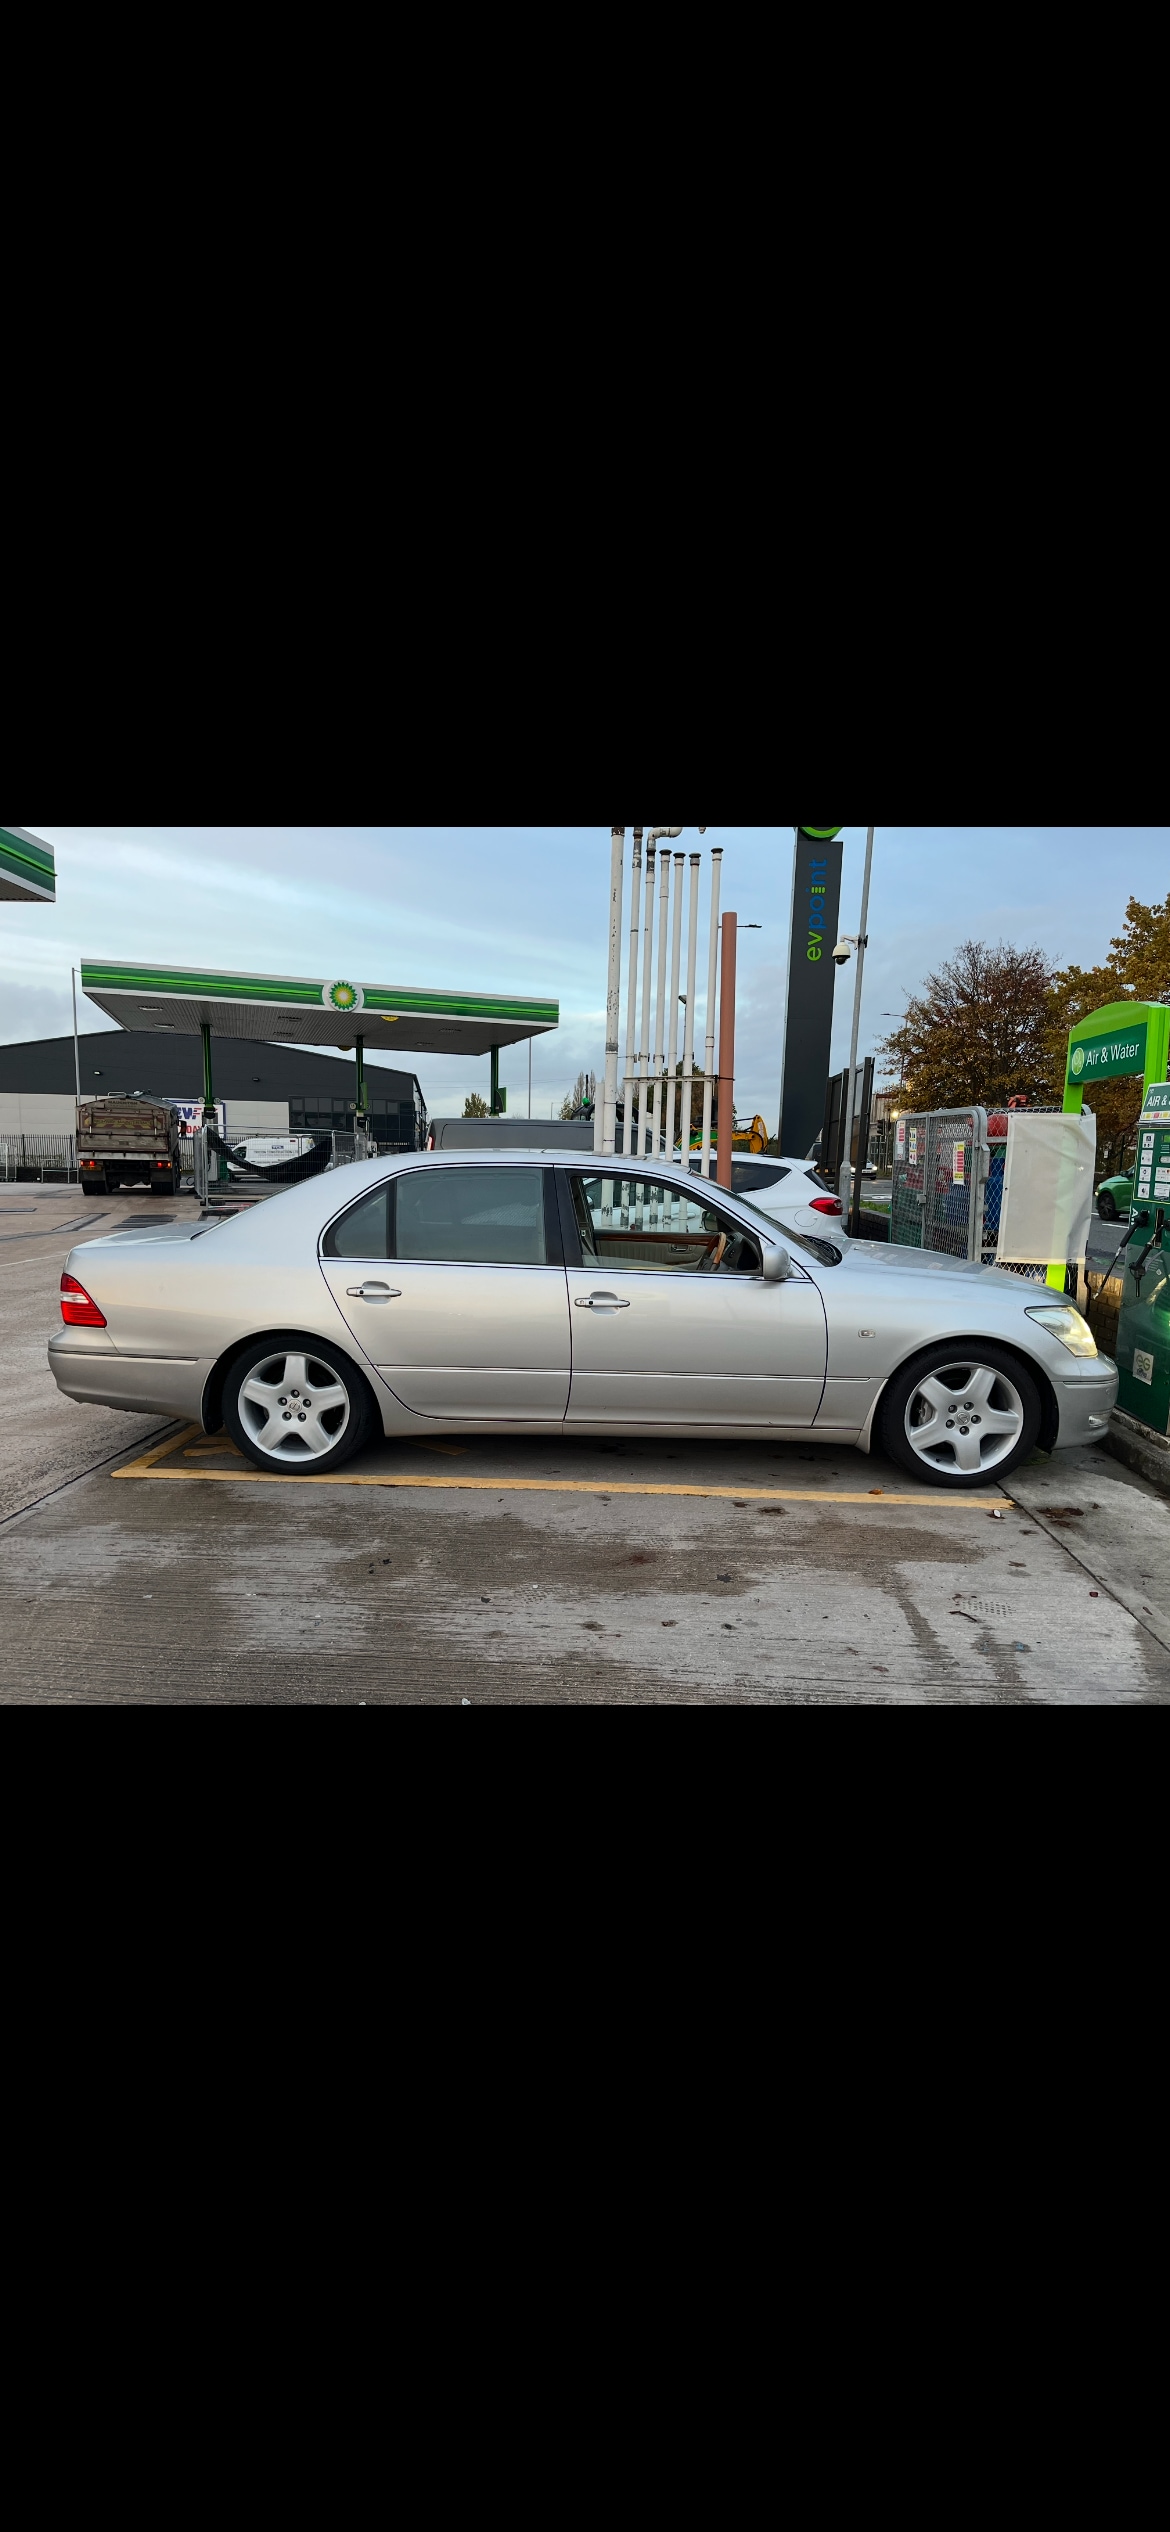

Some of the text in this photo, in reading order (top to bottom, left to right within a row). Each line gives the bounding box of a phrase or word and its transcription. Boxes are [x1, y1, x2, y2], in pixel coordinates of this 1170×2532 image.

[805, 858, 828, 962] evpoint
[1085, 1043, 1140, 1067] Air & Water
[1146, 1095, 1161, 1107] AIR
[1161, 1094, 1168, 1106] &
